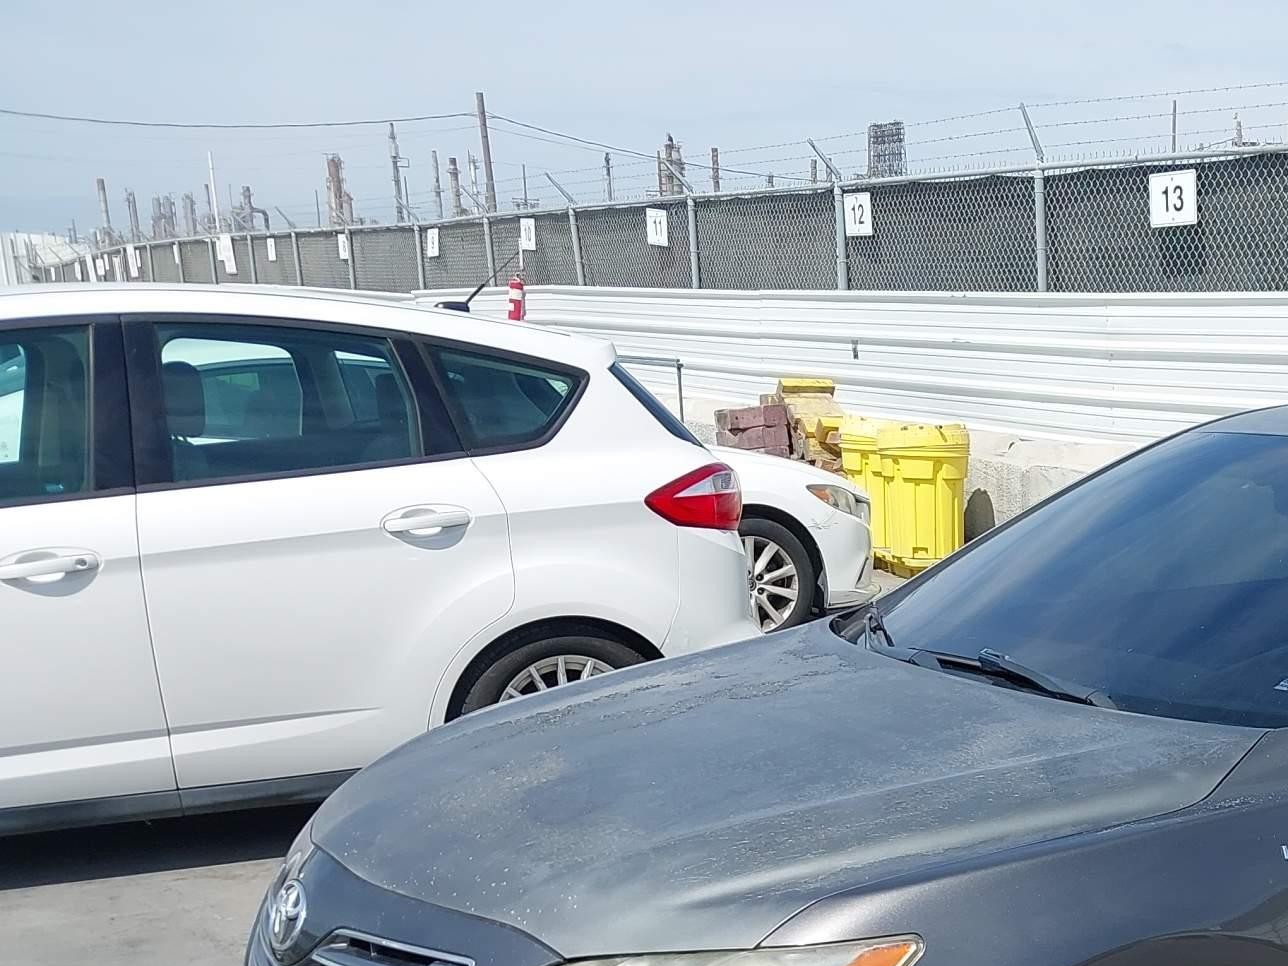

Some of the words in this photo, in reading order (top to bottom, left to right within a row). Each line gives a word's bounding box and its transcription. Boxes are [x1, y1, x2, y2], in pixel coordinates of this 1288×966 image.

[1161, 185, 1185, 213] 13
[851, 203, 865, 225] 12
[652, 218, 663, 237] 11
